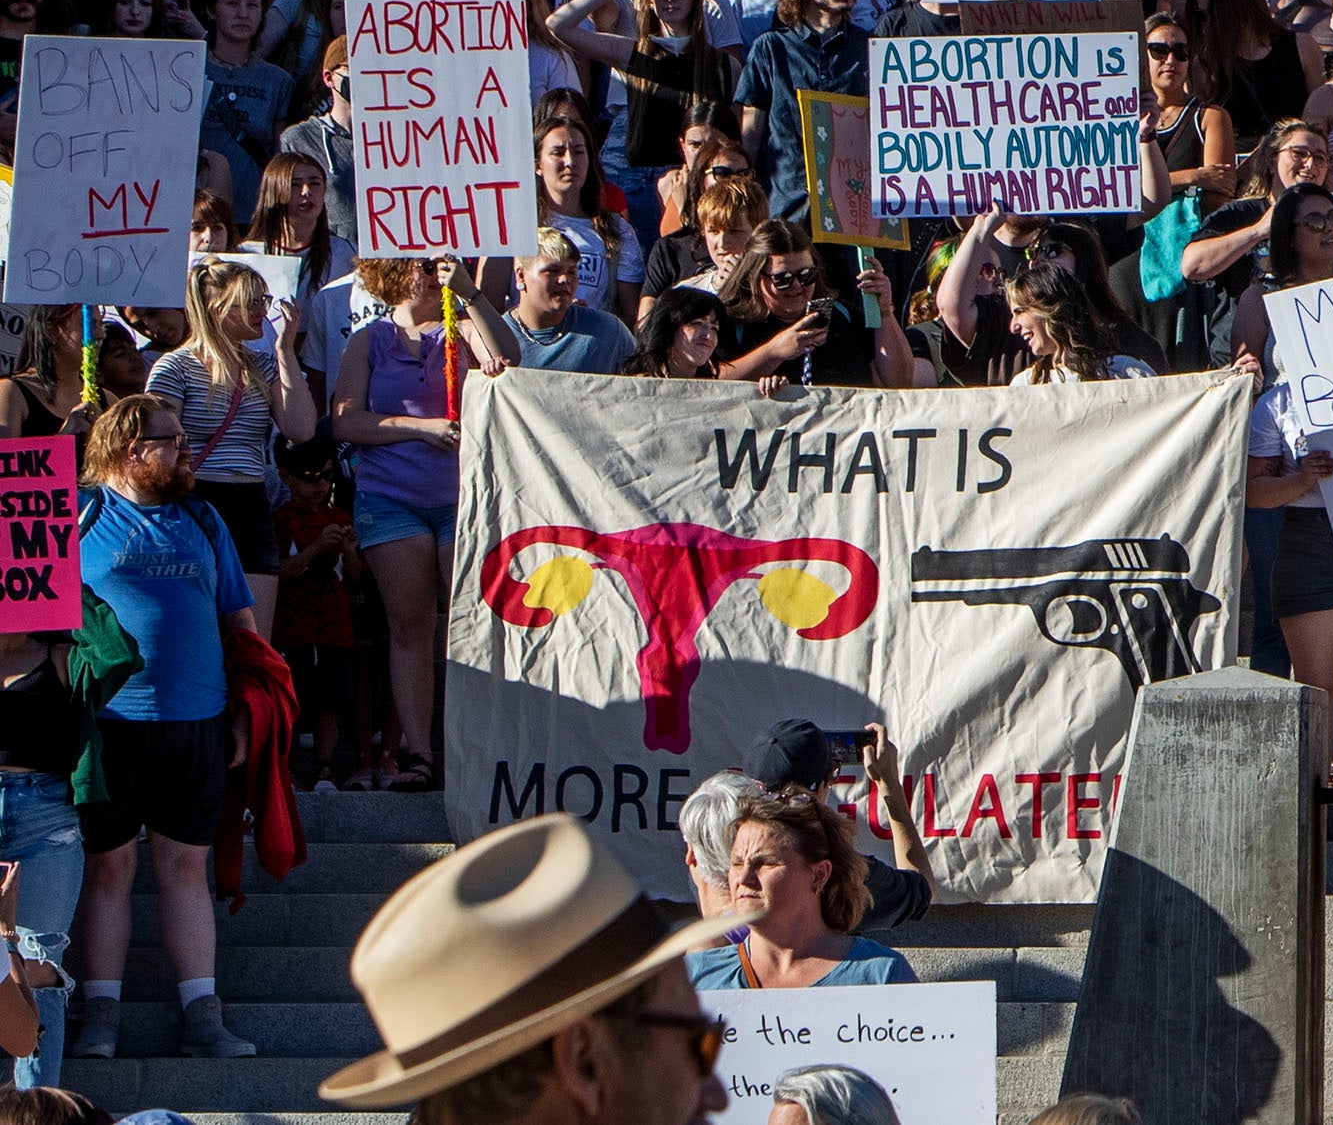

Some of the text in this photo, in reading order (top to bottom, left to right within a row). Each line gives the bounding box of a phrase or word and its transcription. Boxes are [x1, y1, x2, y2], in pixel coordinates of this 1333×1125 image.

[351, 0, 527, 56] ABORTION
[34, 45, 195, 115] BANS
[882, 36, 1078, 84] ABORTION
[360, 67, 508, 111] IS A
[32, 129, 136, 178] OFF
[362, 117, 498, 169] HUMAN
[878, 120, 1139, 174] BODILY AUTONOMY
[366, 181, 520, 250] RIGHT
[881, 165, 1138, 215] IS A HUMAN RIGHT
[23, 244, 158, 296] BODY
[711, 425, 1014, 496] WHAT IS
[10, 520, 73, 560] MY
[756, 1013, 956, 1045] the choice...
